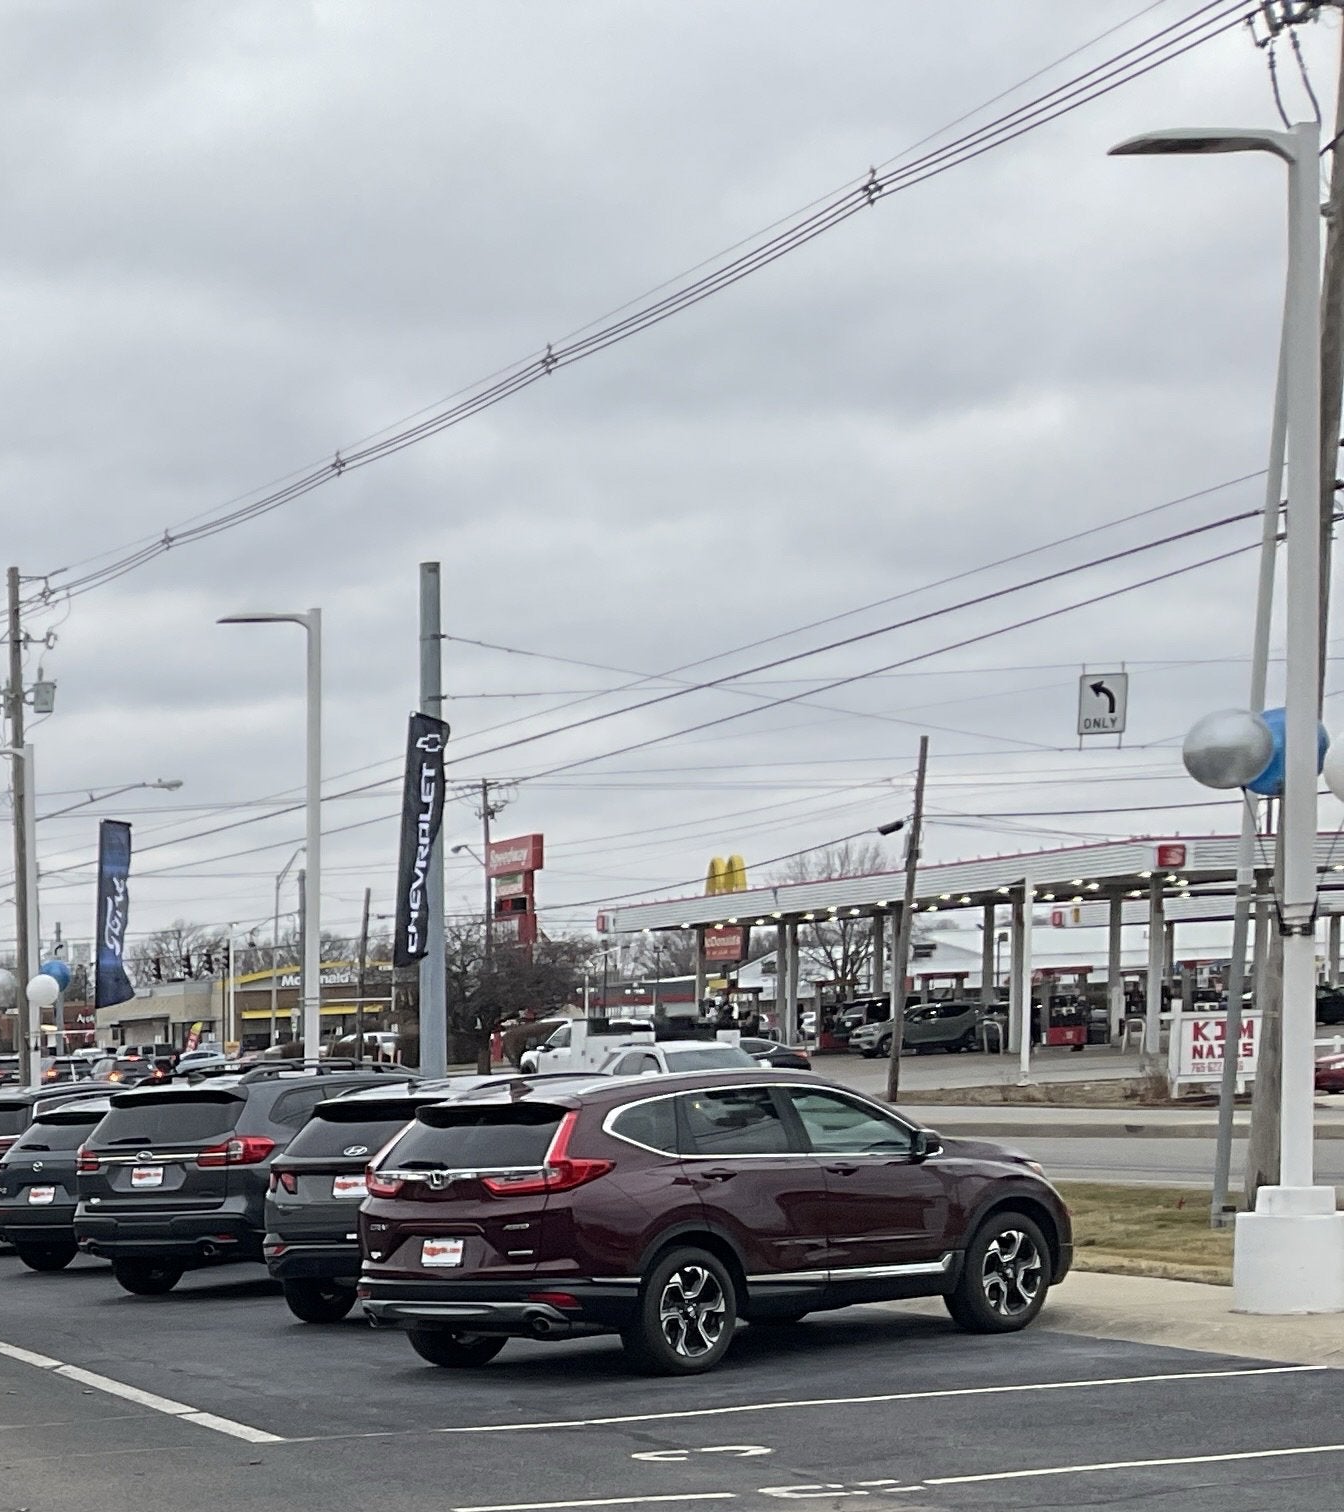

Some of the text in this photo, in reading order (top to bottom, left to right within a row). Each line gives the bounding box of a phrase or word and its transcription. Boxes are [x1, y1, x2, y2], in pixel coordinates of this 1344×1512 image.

[1083, 716, 1117, 730] ONLY
[407, 763, 436, 953] CHEVROLET
[1191, 1043, 1254, 1060] NAIS
